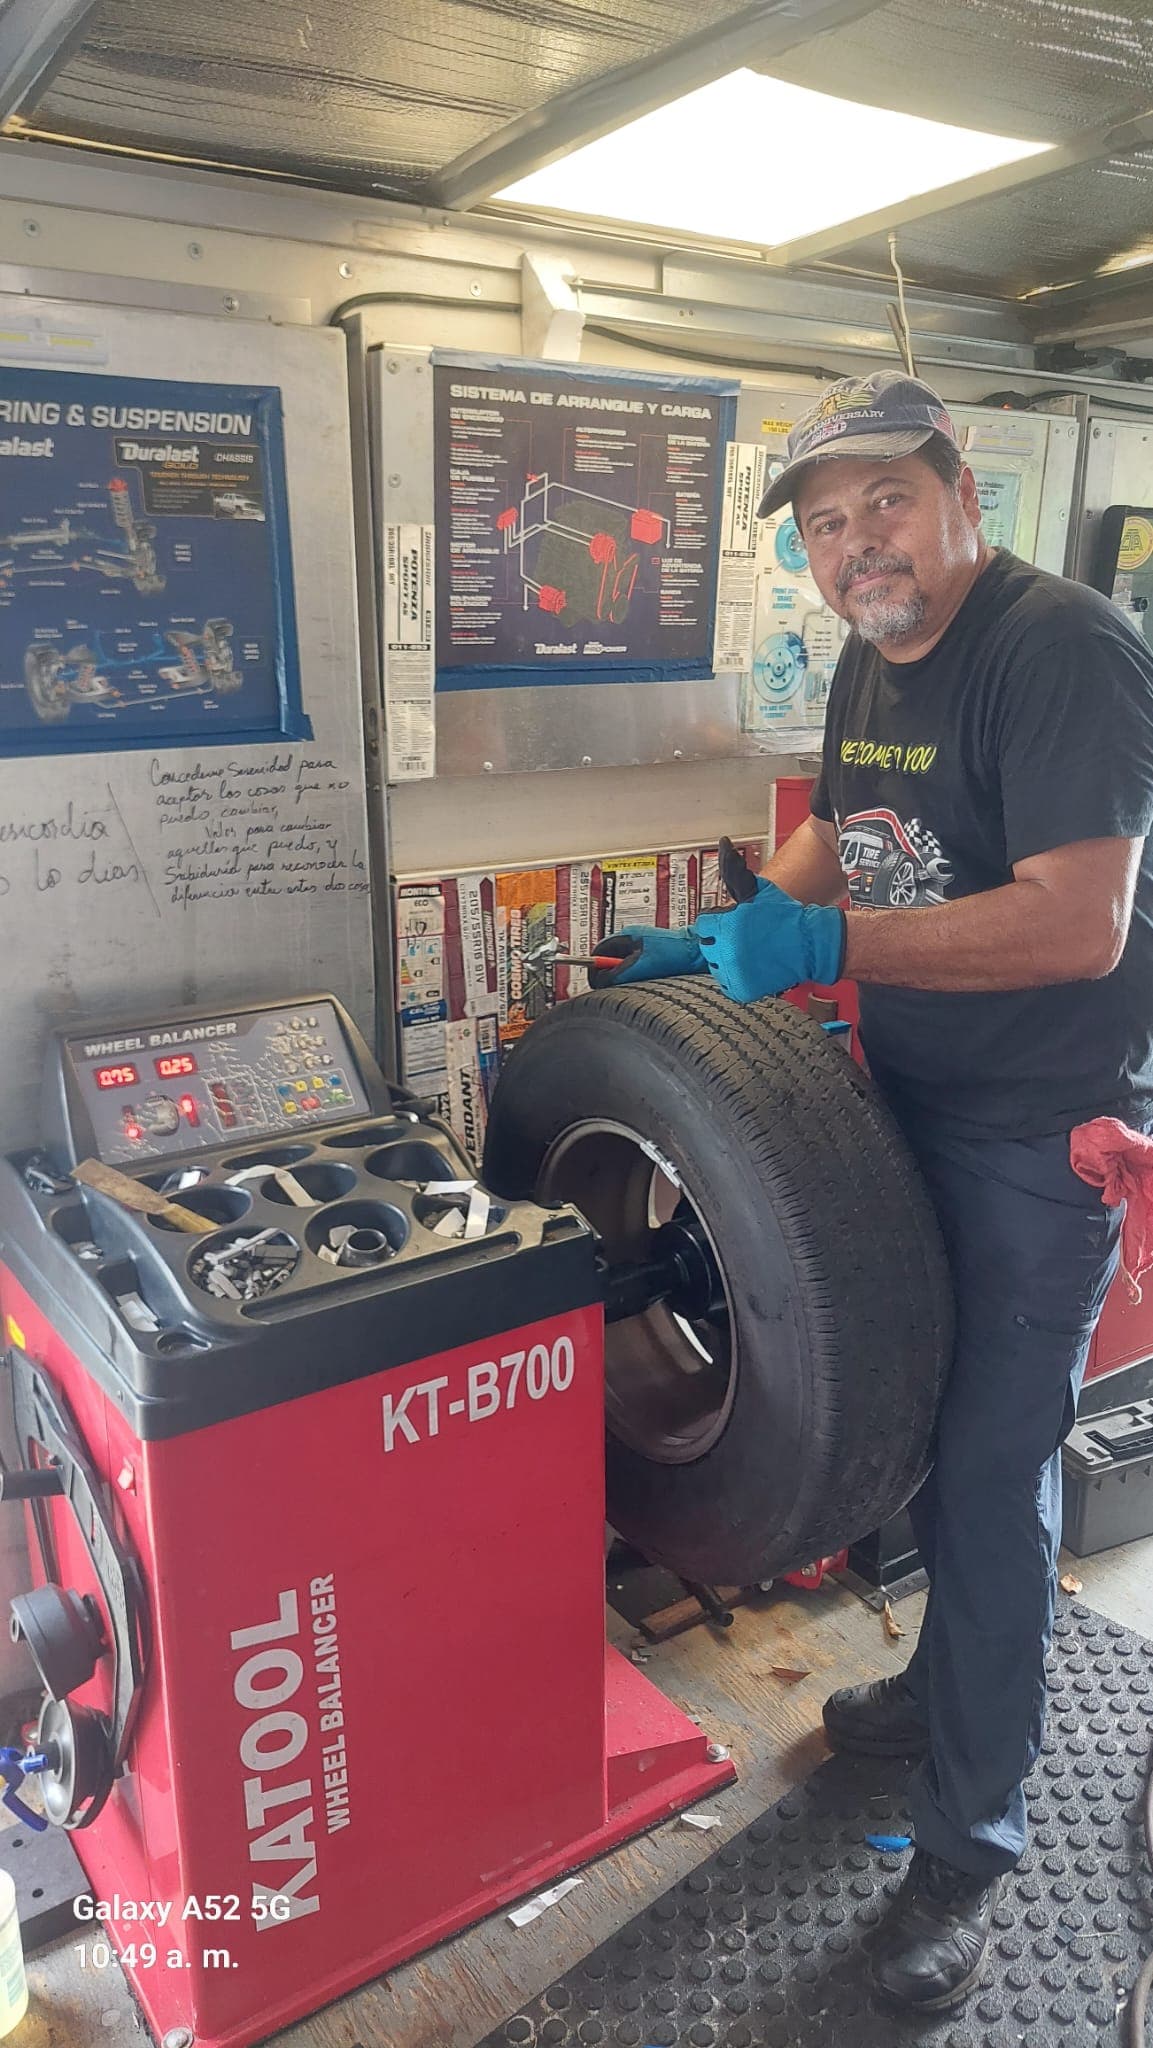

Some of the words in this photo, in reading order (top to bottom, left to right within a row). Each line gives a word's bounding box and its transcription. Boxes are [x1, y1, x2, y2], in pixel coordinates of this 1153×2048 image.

[0, 400, 60, 426] RING
[66, 403, 85, 428] &
[91, 404, 252, 436] SUSPENSION
[449, 384, 527, 403] SISTEMA
[530, 391, 554, 405] DE
[556, 394, 644, 414] ARRANQUE
[646, 402, 659, 415] Y
[661, 404, 712, 420] CARGA
[119, 441, 200, 463] Duralast
[163, 461, 200, 470] GOLD
[214, 452, 255, 465] CHASSIS
[741, 466, 752, 531] POTENZA
[410, 549, 419, 621] POTENZA
[299, 759, 337, 782] para
[903, 746, 937, 771] YOU
[294, 783, 320, 804] que
[231, 843, 257, 861] que
[325, 839, 338, 861] y
[246, 823, 274, 841] para
[247, 861, 275, 881] para
[352, 850, 366, 871] la
[863, 846, 881, 860] TIRE
[468, 890, 484, 960] 205/55R16
[510, 909, 521, 947] TIRES
[474, 963, 485, 984] 91V
[510, 949, 522, 1000] COSMO
[85, 1038, 145, 1058] WHEEL
[150, 1022, 237, 1047] BALANCER
[382, 1336, 575, 1453] KT-B700
[309, 1573, 346, 1732] BALANCER
[230, 1588, 320, 1932] KATOOL
[320, 1734, 351, 1834] WHEEL
